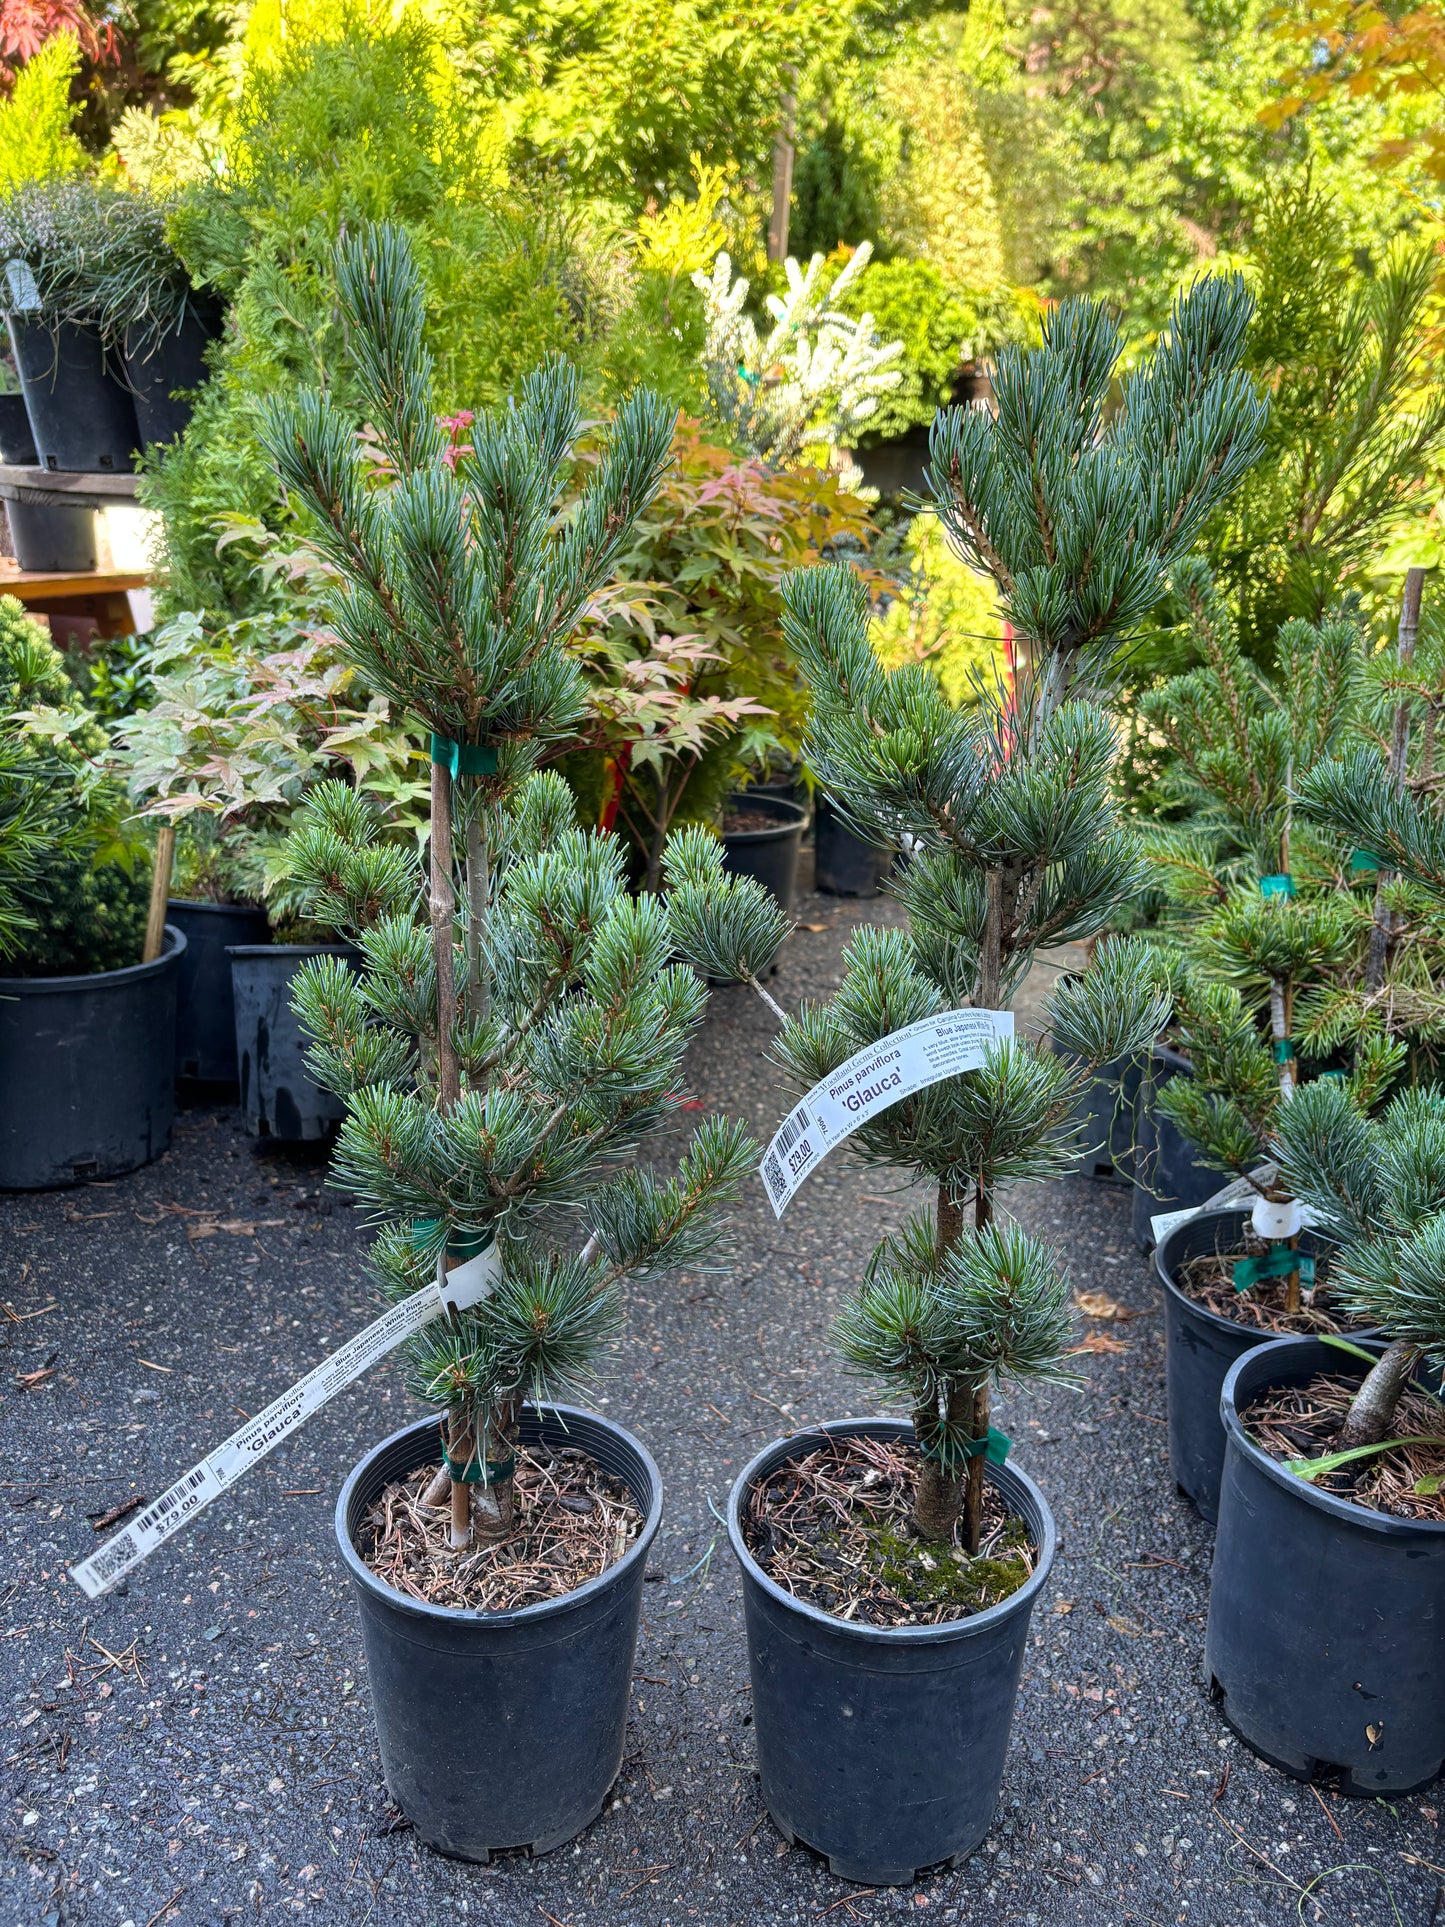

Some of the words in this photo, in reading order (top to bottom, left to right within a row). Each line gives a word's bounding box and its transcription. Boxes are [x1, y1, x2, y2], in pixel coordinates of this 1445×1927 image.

[935, 1025, 953, 1036] Blue
[828, 1077, 854, 1099] Pinus
[855, 1048, 901, 1083] parviflora
[851, 1050, 872, 1067] Gems
[841, 1065, 902, 1111] 'Glauca'
[787, 1139, 811, 1172] $79.00
[334, 1351, 351, 1366] Blue
[350, 1326, 384, 1354] Japanese
[384, 1311, 405, 1327] White
[405, 1300, 422, 1313] Pine
[235, 1425, 262, 1449] Pinus
[262, 1390, 304, 1427] parviflora
[246, 1403, 301, 1452] 'Glauca'
[262, 1399, 282, 1418] Gems
[154, 1493, 199, 1534] $79.00
